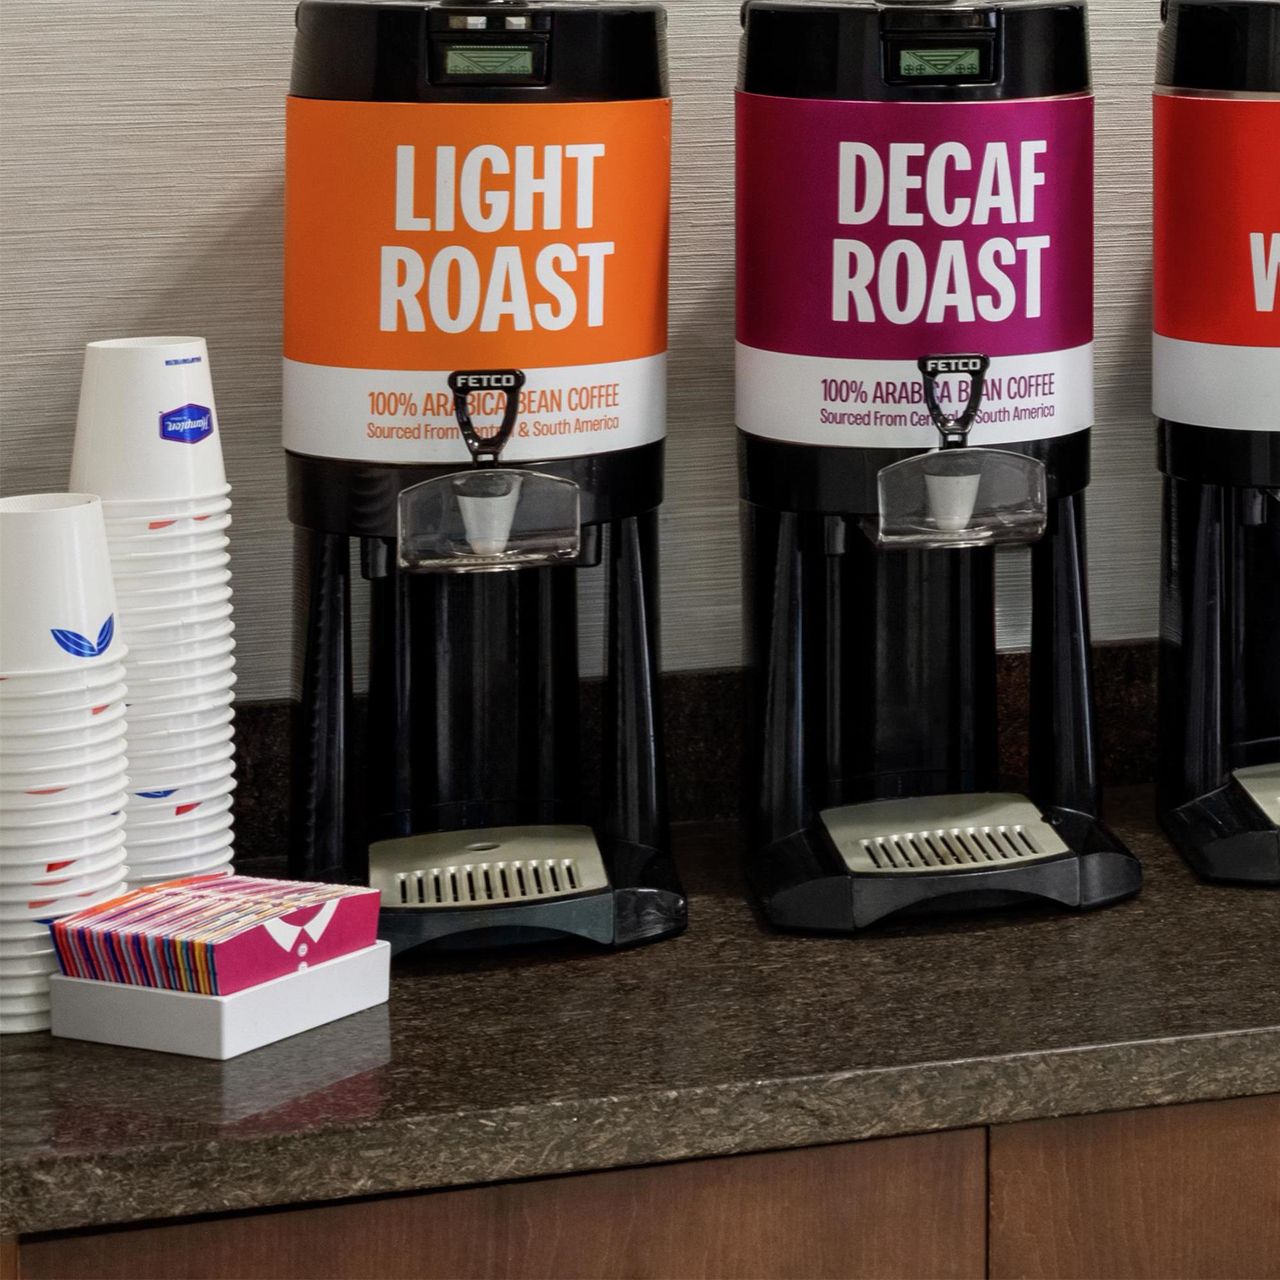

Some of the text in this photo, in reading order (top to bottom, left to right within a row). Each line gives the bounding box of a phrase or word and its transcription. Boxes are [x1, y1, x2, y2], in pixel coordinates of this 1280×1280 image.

[395, 144, 605, 233] LIGHT
[838, 140, 1047, 227] DECAF
[380, 241, 615, 333] ROAST
[832, 235, 1050, 325] ROAST
[457, 375, 514, 387] FETCO
[927, 359, 981, 372] FETCO
[369, 391, 418, 417] 100%
[567, 383, 620, 411] COFFEE
[821, 373, 1055, 404] 100% ARABCA BAN COFFEE
[367, 422, 420, 439] Sourced
[424, 423, 460, 440] From
[518, 421, 531, 437] &
[533, 418, 573, 436] South
[574, 414, 620, 432] America
[820, 408, 870, 426] Sourced
[874, 410, 907, 426] From
[975, 407, 1011, 424] South
[1013, 402, 1055, 420] America
